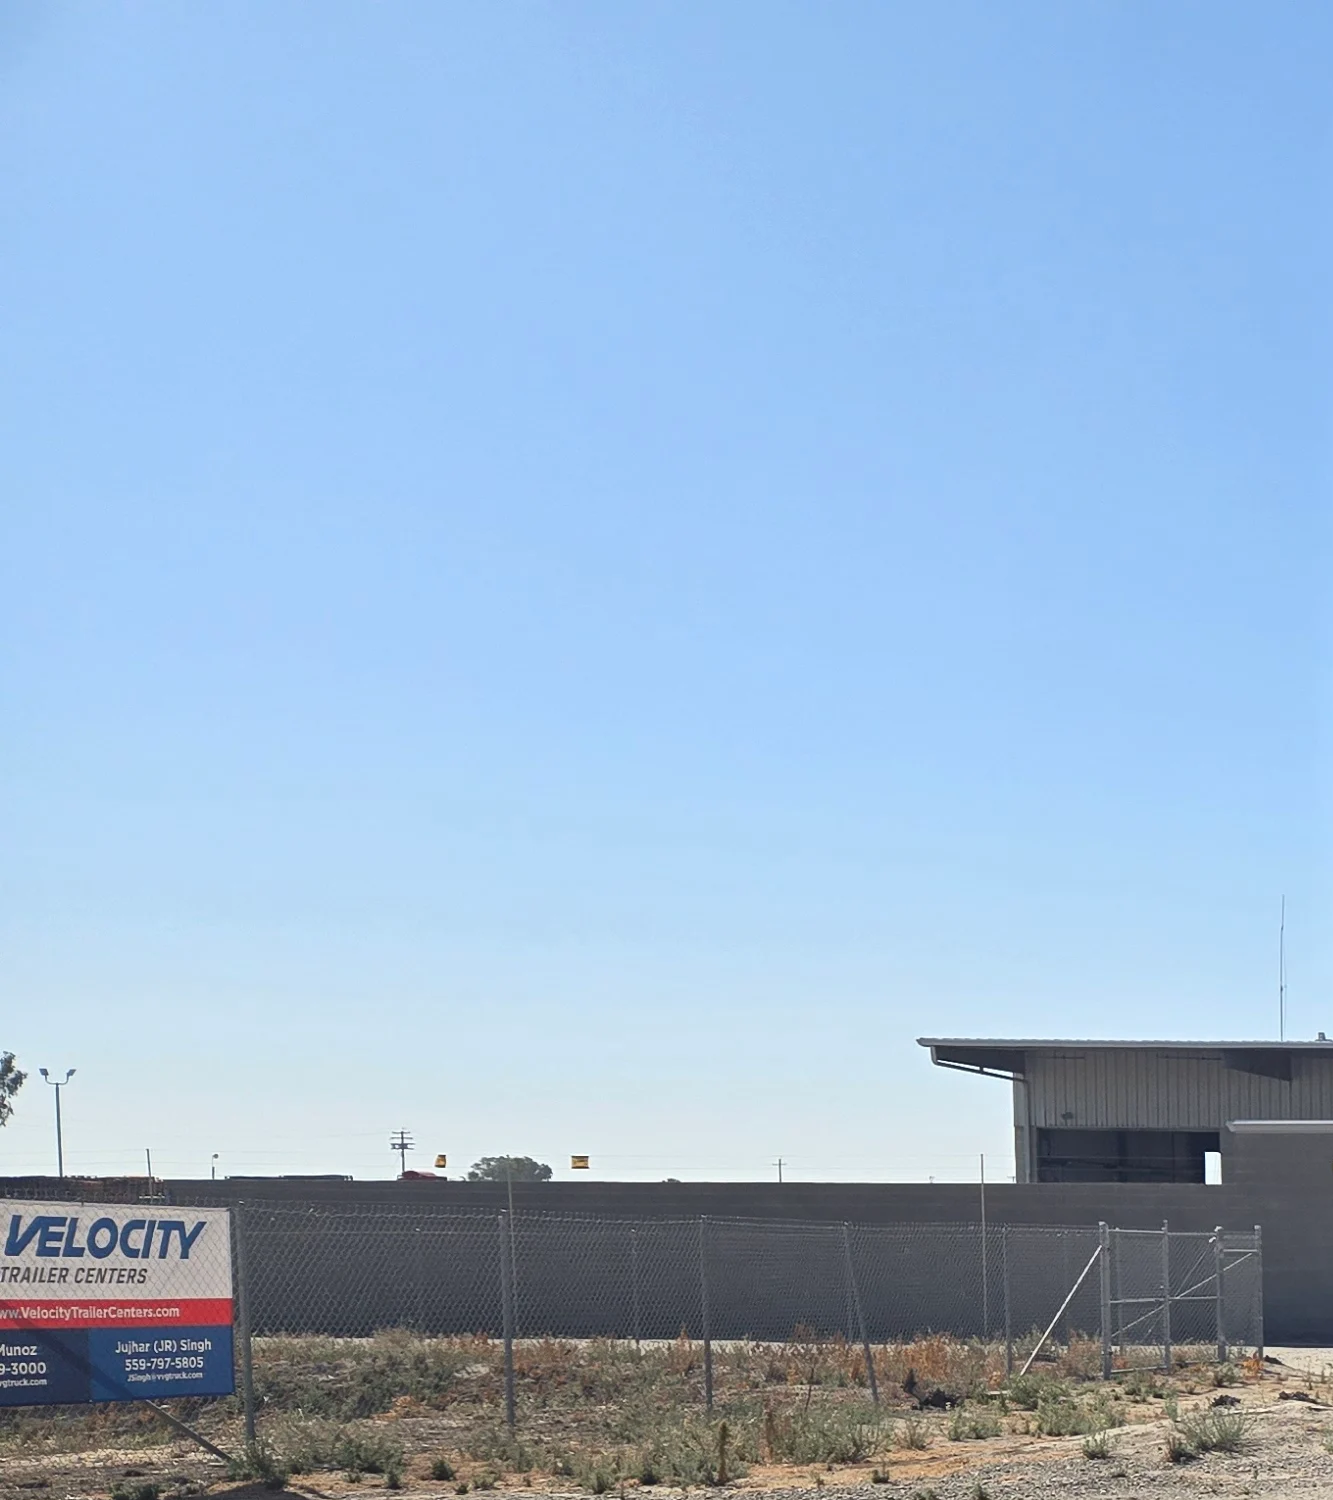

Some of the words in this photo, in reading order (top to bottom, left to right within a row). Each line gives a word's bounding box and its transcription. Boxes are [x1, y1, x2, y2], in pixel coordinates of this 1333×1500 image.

[5, 1215, 207, 1260] VELOCITY
[0, 1267, 69, 1283] TRAILER
[74, 1268, 148, 1284] CENTERS
[115, 1341, 151, 1355] Jujhar
[154, 1340, 177, 1353] (JR)
[180, 1338, 212, 1352] Singh
[125, 1357, 204, 1371] 559-797-5805
